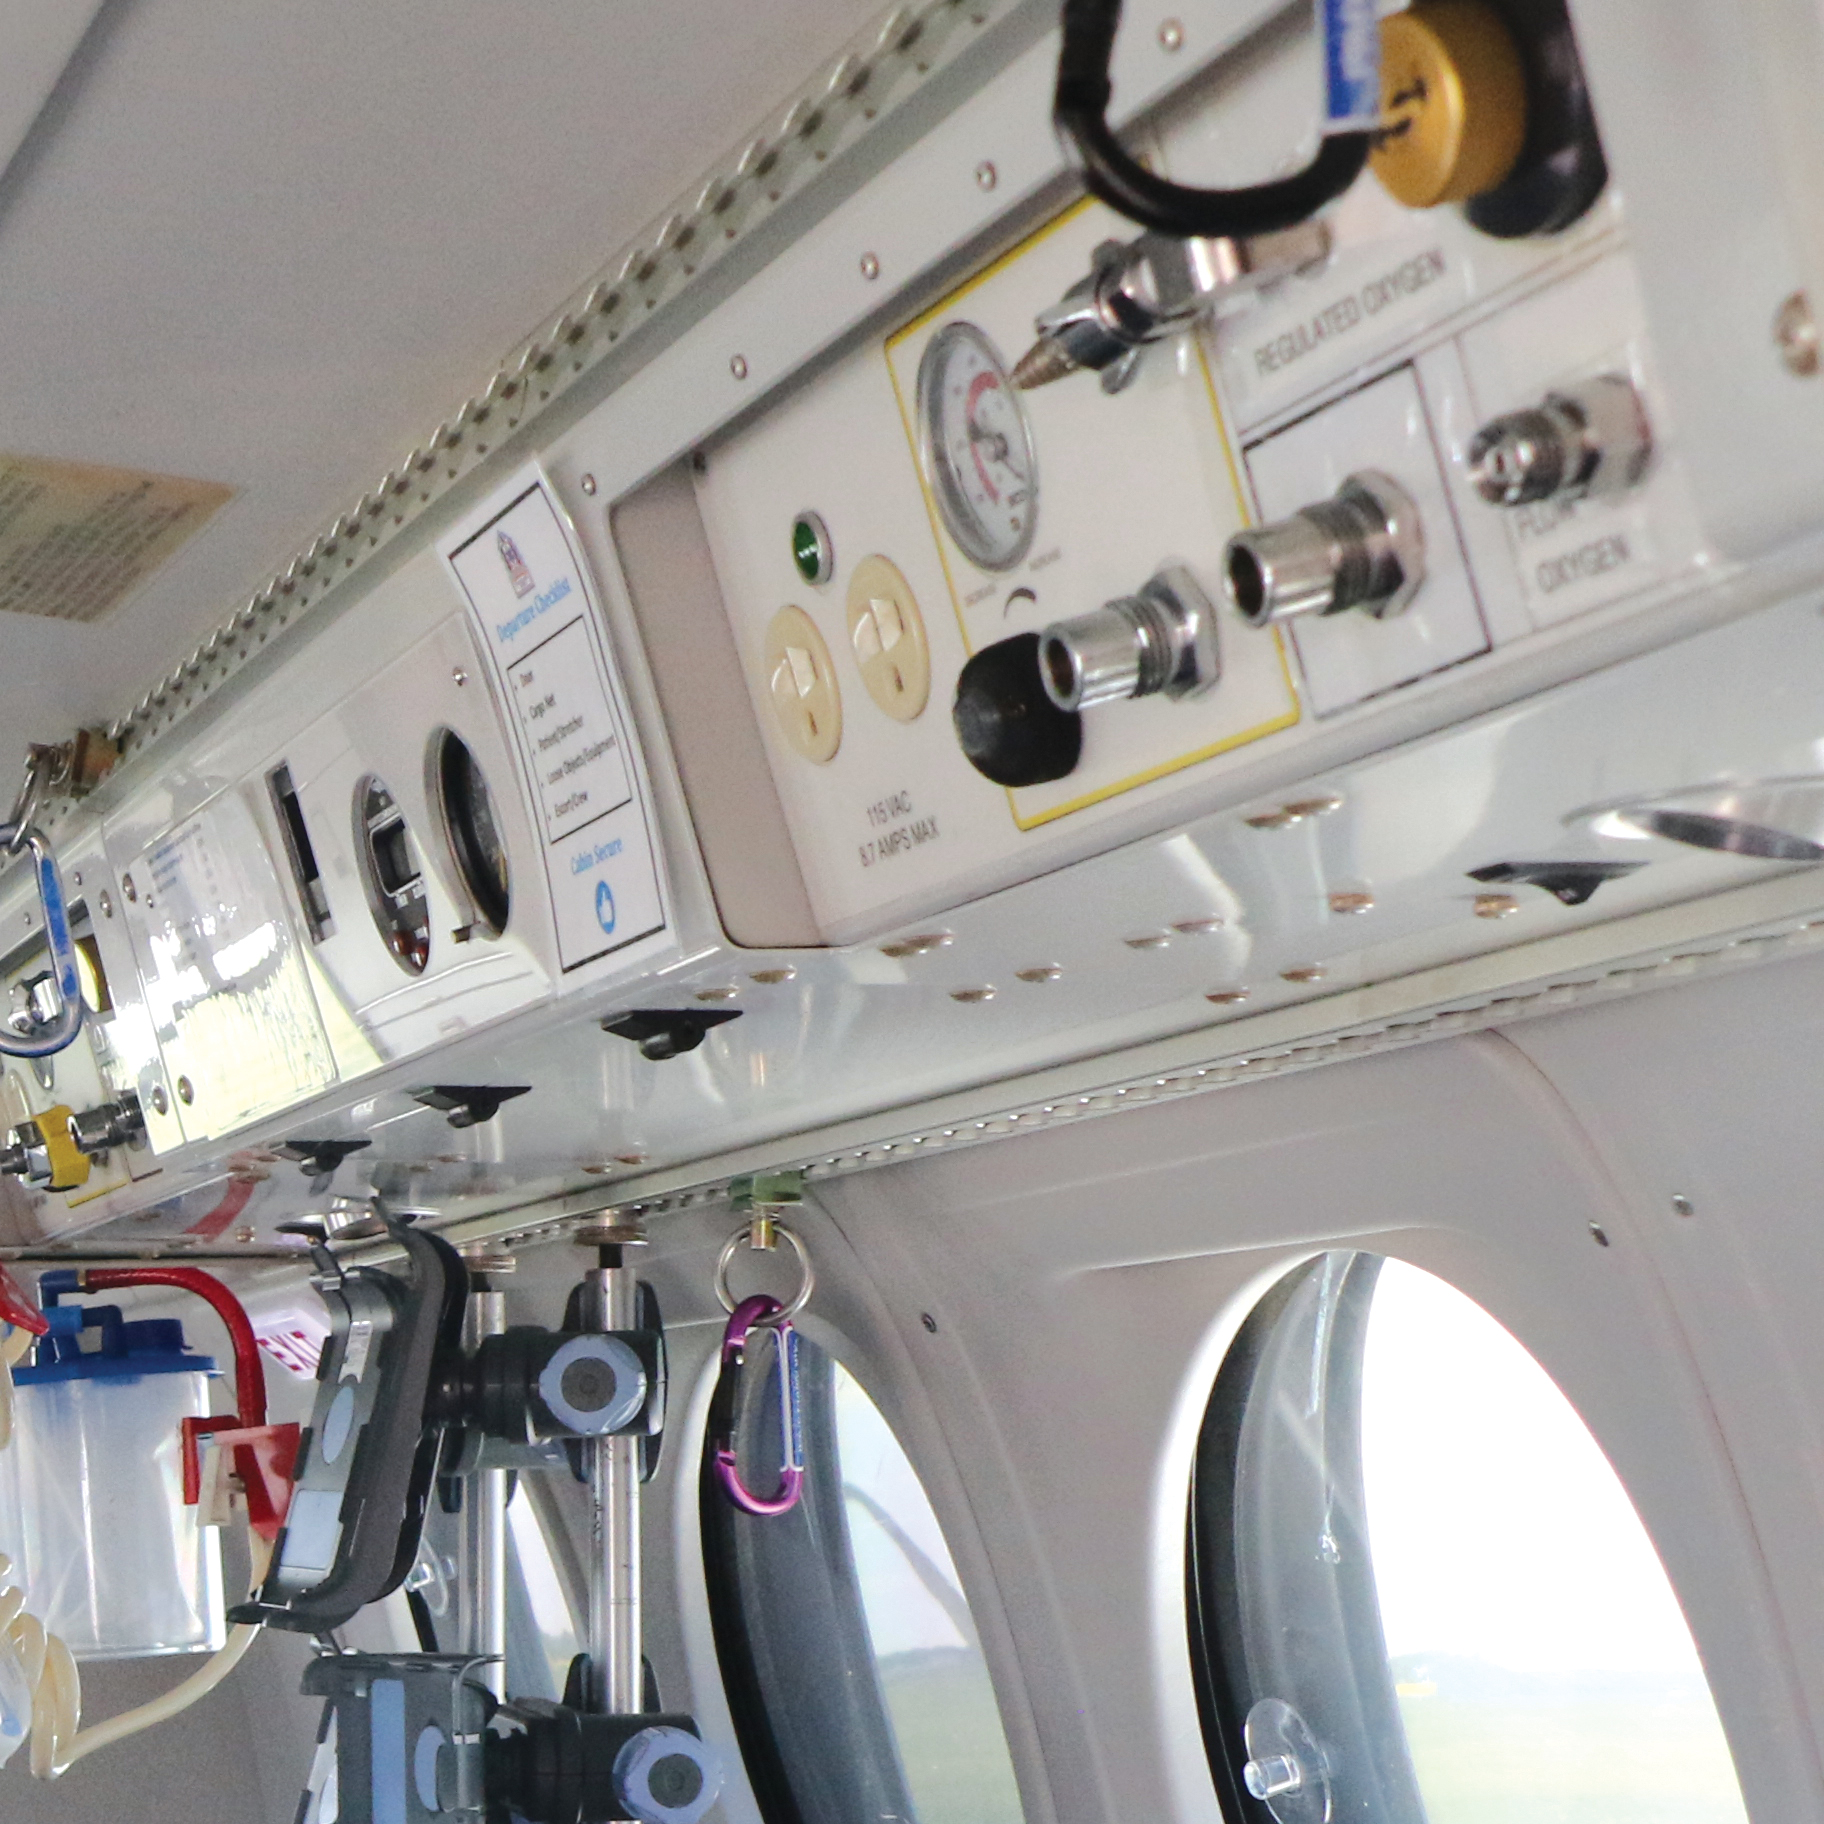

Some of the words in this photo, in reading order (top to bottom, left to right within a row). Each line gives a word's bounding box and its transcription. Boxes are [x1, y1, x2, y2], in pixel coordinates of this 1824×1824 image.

[1254, 294, 1361, 376] REGULATED
[1361, 247, 1447, 316] OXYGEN
[1535, 532, 1632, 594] OXYGEN
[496, 606, 535, 643] Departure
[534, 577, 571, 614] Checklist
[866, 801, 888, 828] 115
[885, 789, 912, 817] VAC
[593, 838, 623, 864] Secure
[877, 827, 911, 859] AMPS
[909, 815, 940, 844] MAX
[254, 1330, 321, 1372] EXIT
